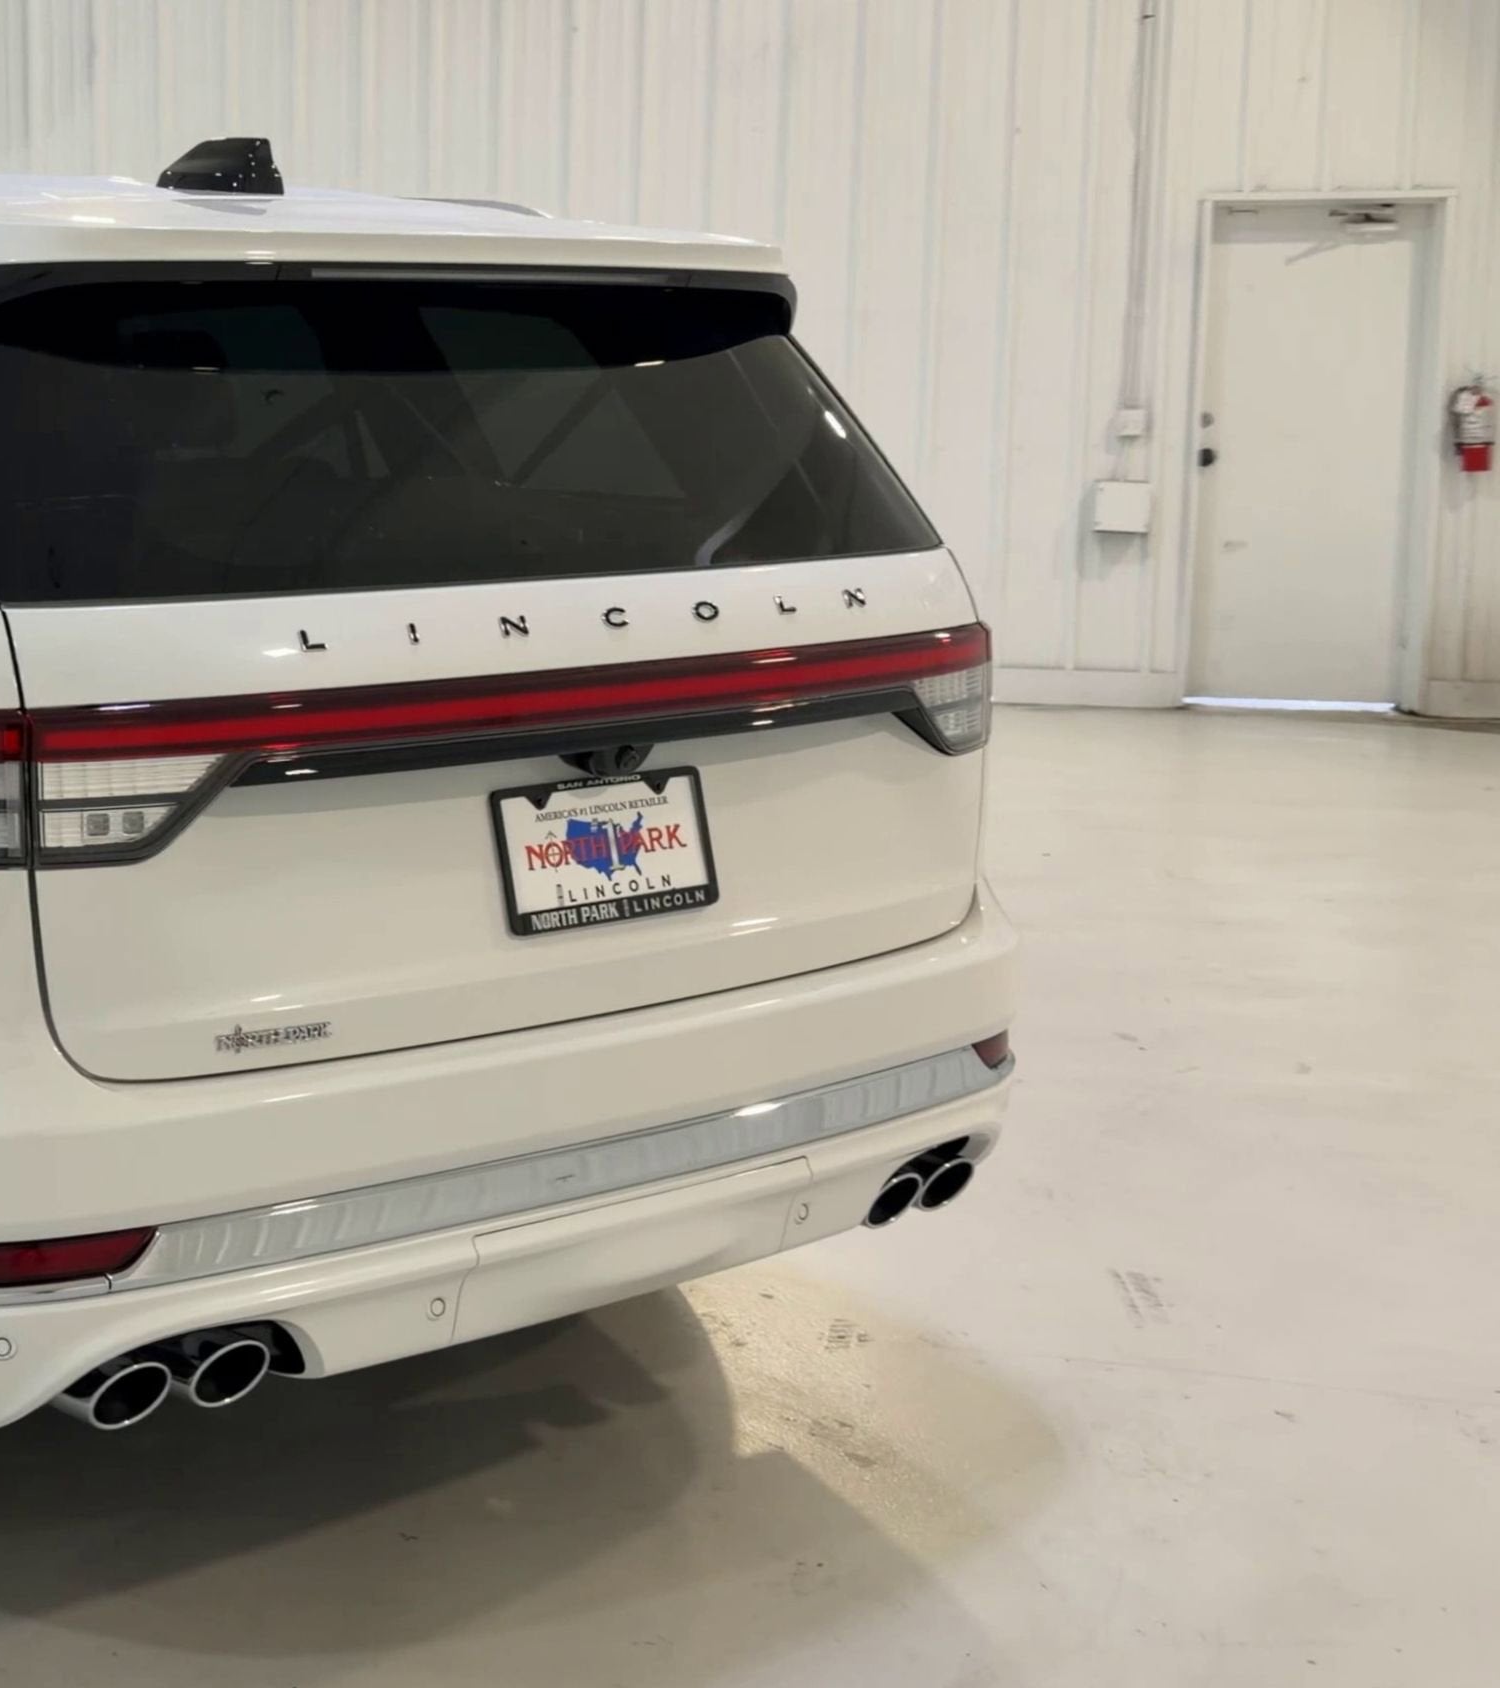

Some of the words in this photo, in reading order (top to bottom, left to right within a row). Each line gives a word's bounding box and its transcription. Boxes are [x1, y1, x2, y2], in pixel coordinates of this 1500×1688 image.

[299, 586, 868, 653] LINCOLN
[556, 781, 583, 791] SAN
[586, 773, 642, 787] ANTONIO
[588, 801, 629, 815] LINCOLN
[628, 795, 669, 811] RETAILER
[524, 835, 610, 872] NORTH
[618, 823, 688, 855] PARK
[567, 874, 673, 903] LINCOLN
[530, 907, 579, 932] NORTH
[581, 901, 620, 924] PARK
[632, 889, 706, 914] LINCOLN
[214, 1025, 282, 1053] NORTH
[283, 1021, 333, 1044] PARK
